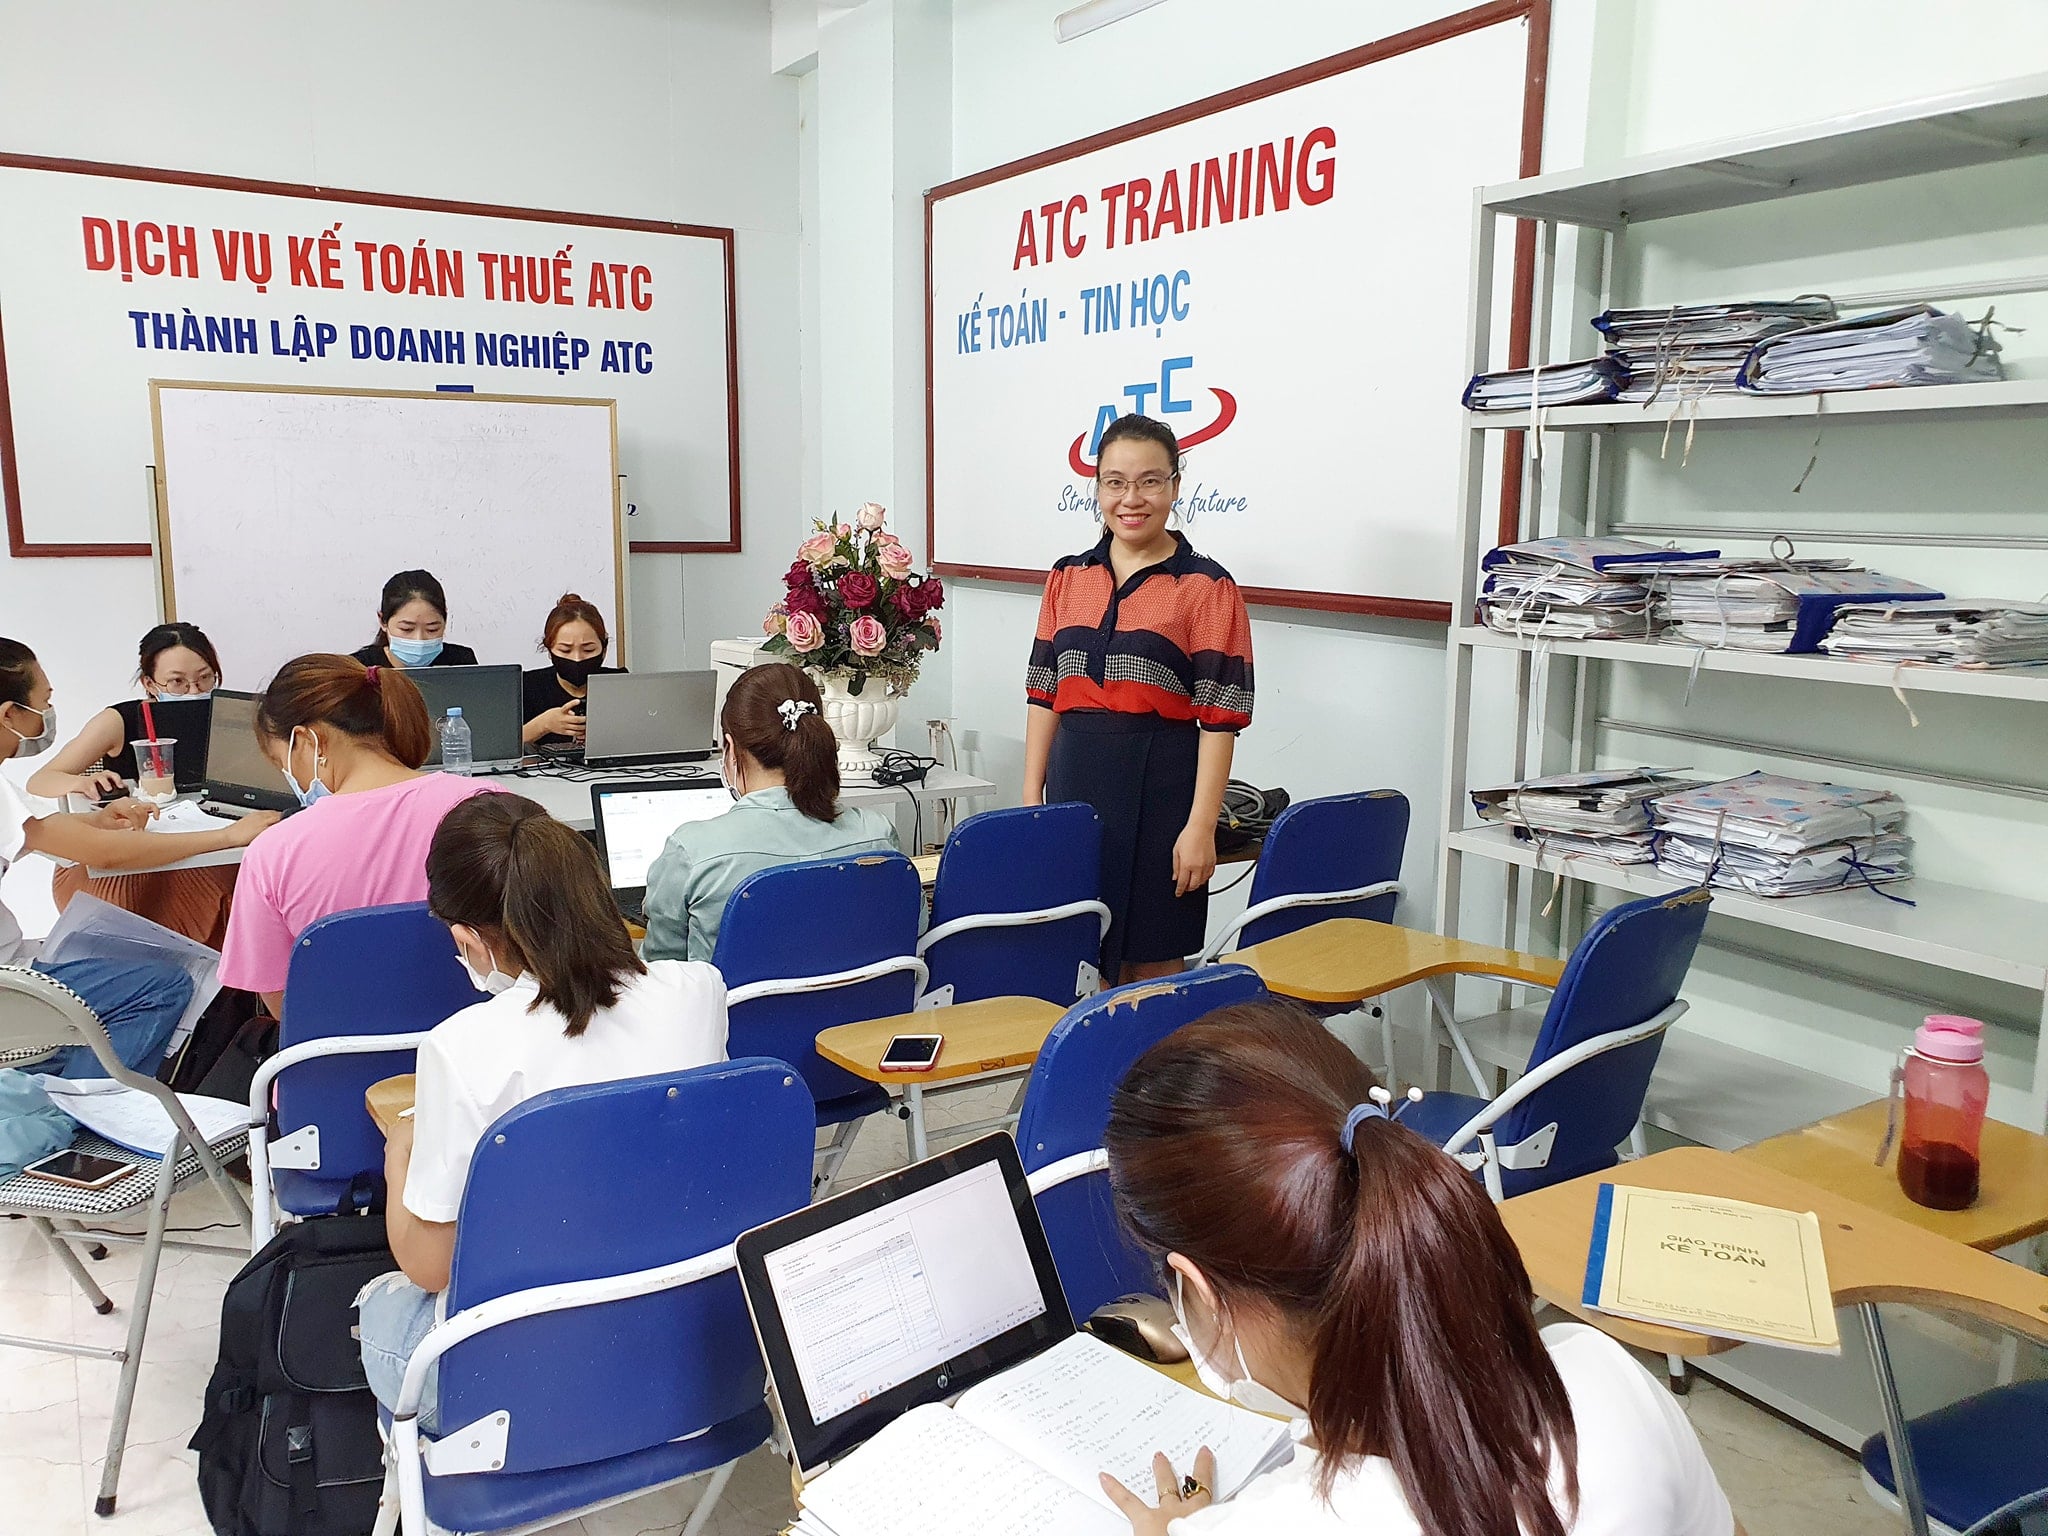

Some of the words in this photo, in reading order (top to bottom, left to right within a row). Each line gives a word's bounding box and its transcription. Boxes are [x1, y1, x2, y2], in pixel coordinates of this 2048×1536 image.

[1013, 194, 1088, 271] ATC
[1101, 126, 1336, 249] TRAINING
[82, 216, 199, 283] DỊCH
[212, 229, 272, 294] VỤ
[287, 222, 344, 289] KẾ
[354, 239, 465, 298] TOÁN
[477, 244, 574, 306] THUẾ
[587, 262, 653, 312] ATC
[128, 307, 258, 354] THÀNH
[270, 314, 337, 362] LẬP
[350, 325, 466, 365] DOANH
[475, 331, 590, 376] NGHIỆP
[600, 340, 653, 375] ATC
[957, 291, 983, 354] KẾ
[987, 287, 1047, 348] TOÁN
[1080, 283, 1121, 335] TIN
[1130, 269, 1191, 337] HỌC
[1186, 482, 1248, 524] future
